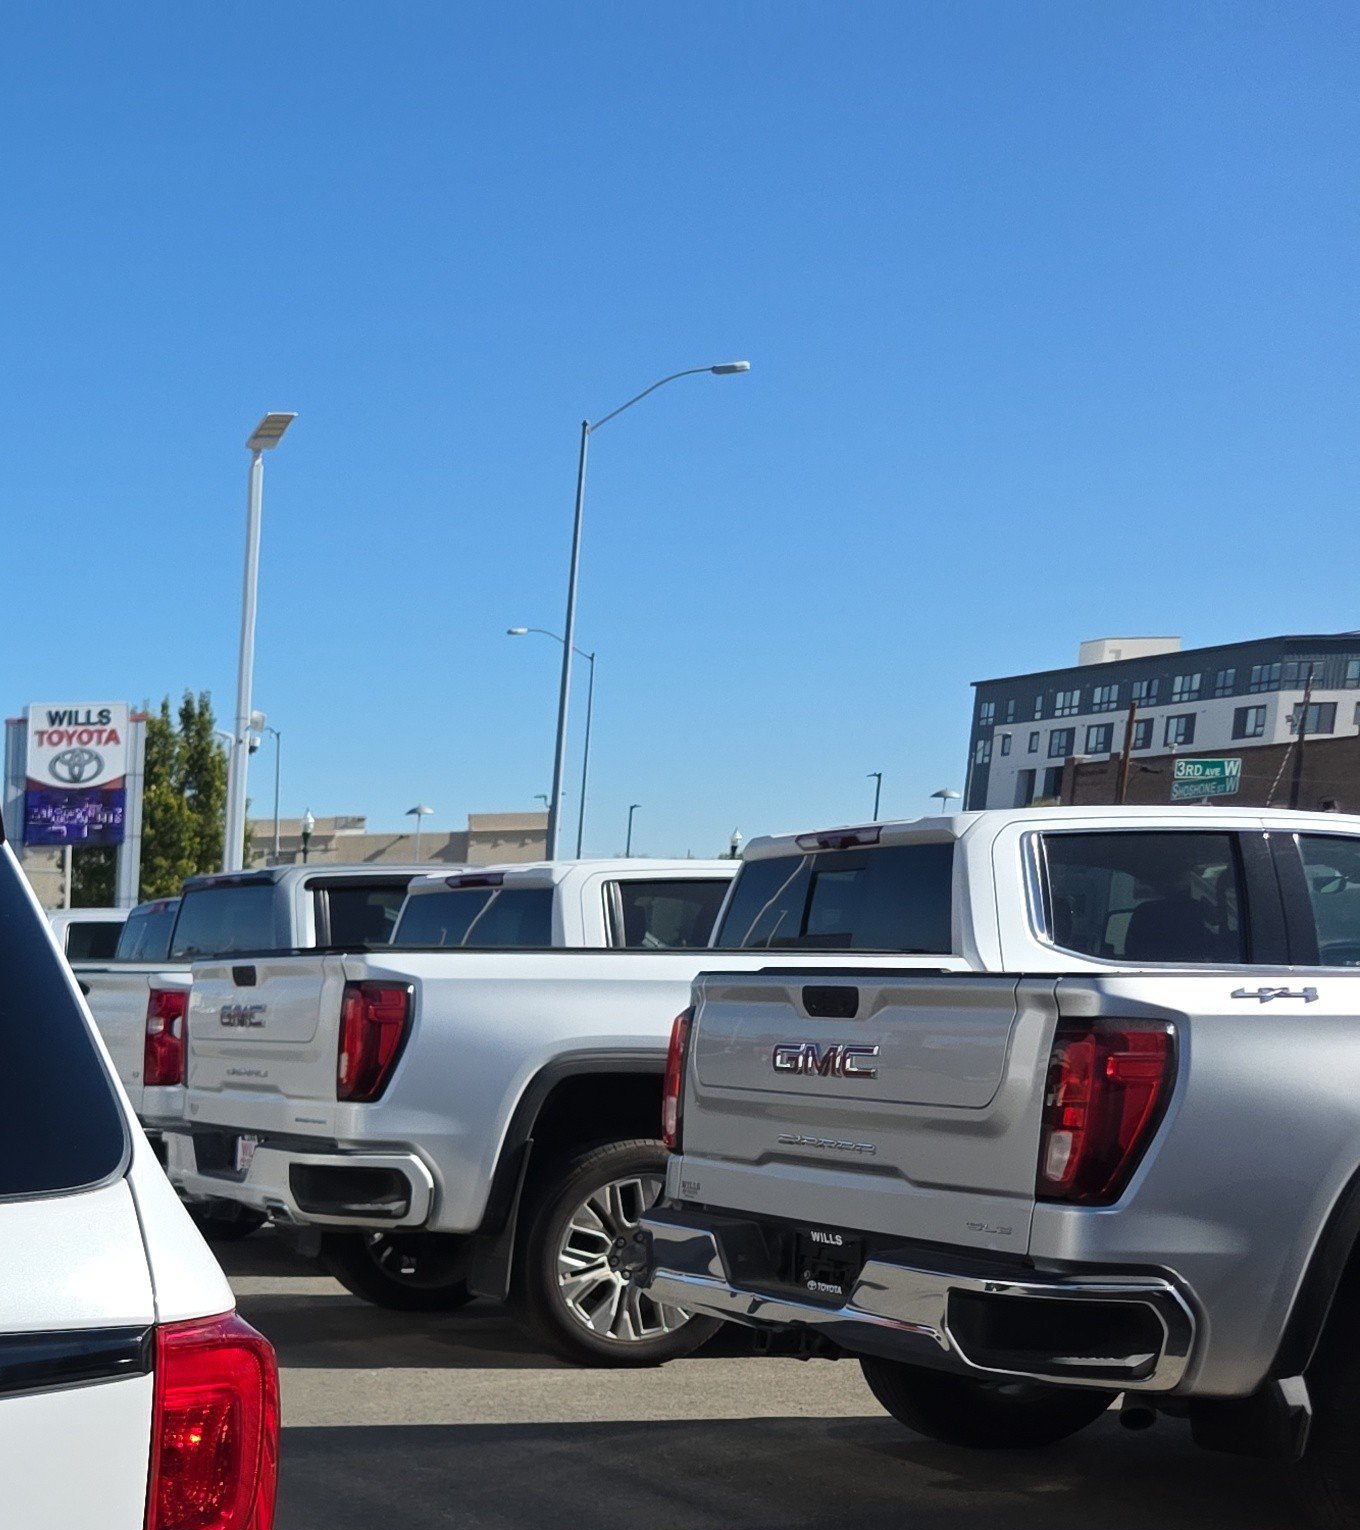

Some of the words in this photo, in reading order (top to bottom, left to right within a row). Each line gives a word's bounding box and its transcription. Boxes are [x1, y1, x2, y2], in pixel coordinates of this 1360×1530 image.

[47, 708, 112, 727] WILLS
[34, 728, 121, 747] TOYOTA
[1177, 761, 1203, 776] 3RD
[1204, 767, 1221, 776] AVE
[1224, 760, 1240, 776] W
[220, 1004, 267, 1027] GMC
[773, 1043, 880, 1079] GMC
[810, 1231, 843, 1246] WILLS
[817, 1282, 842, 1294] TOYOTA
